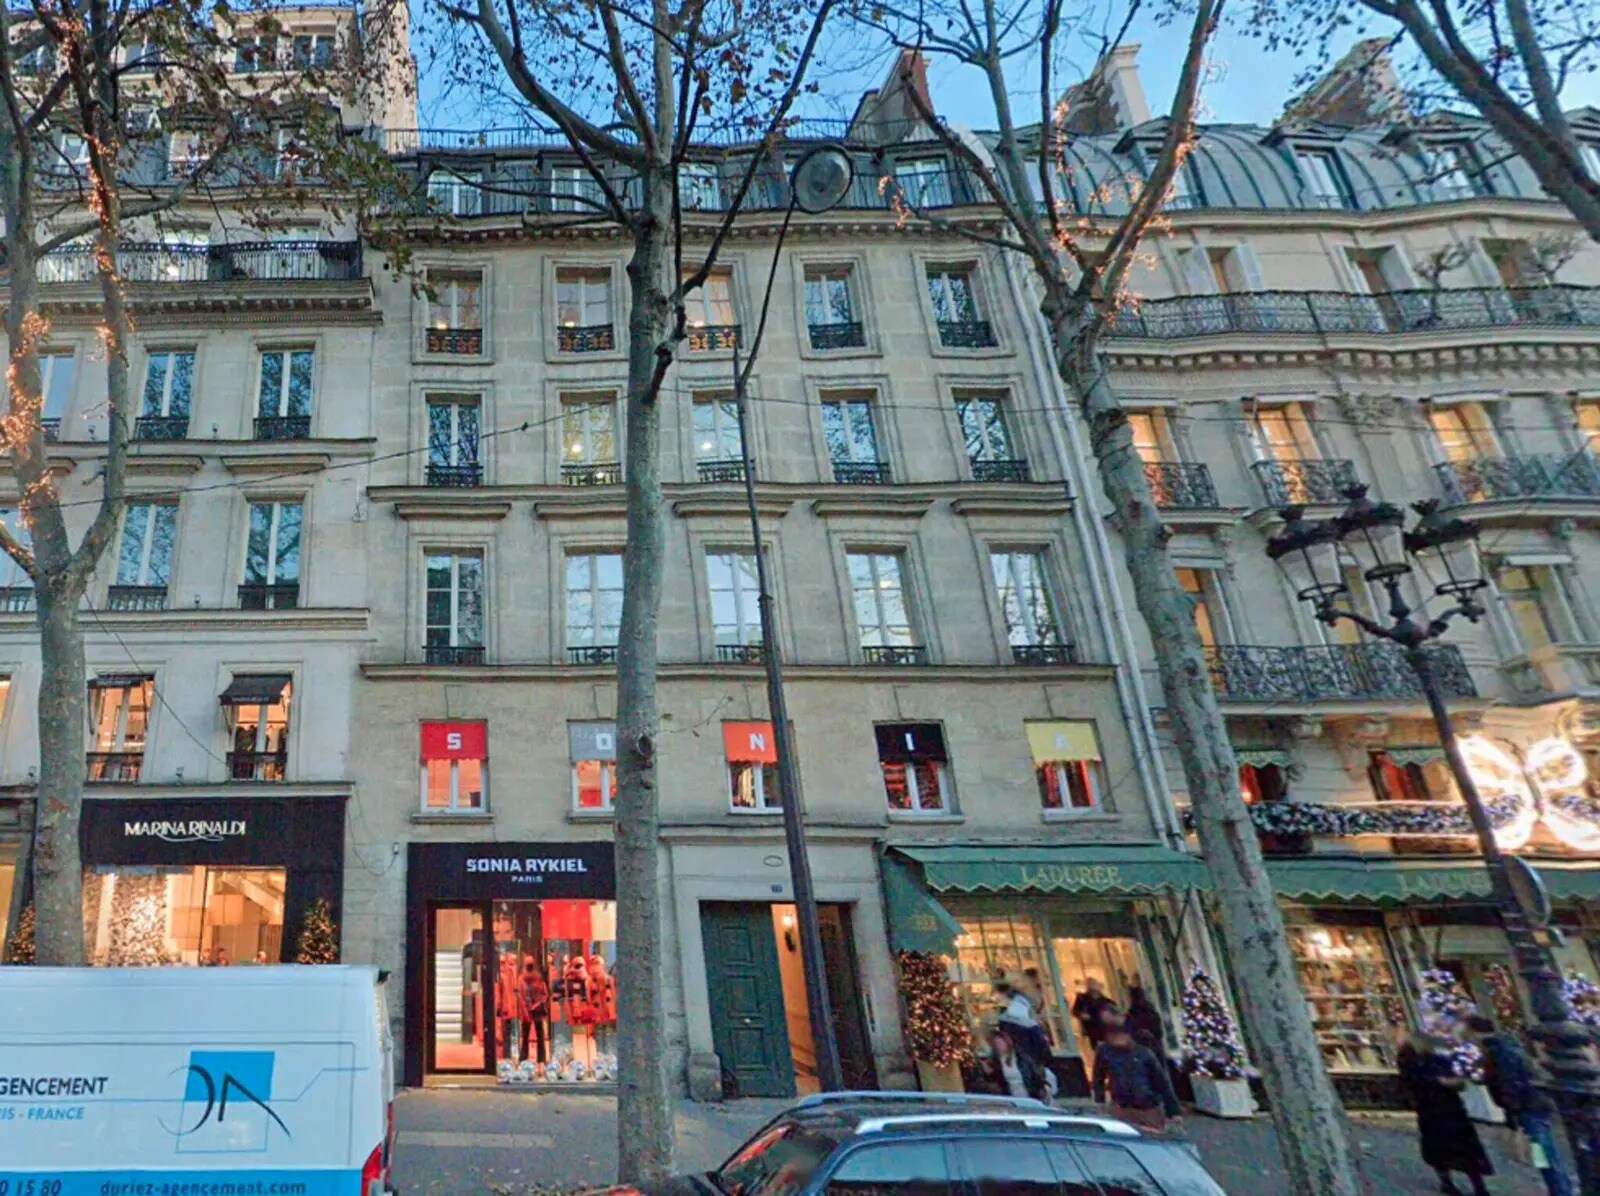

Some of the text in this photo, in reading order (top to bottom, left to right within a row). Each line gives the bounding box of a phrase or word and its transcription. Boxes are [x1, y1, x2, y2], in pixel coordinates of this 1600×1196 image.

[447, 733, 462, 750] S
[748, 732, 766, 752] N
[905, 733, 915, 750] I
[1052, 731, 1072, 752] A
[125, 821, 247, 839] MARINA RINALDI
[466, 858, 588, 872] SONIA RYKIEL
[511, 875, 544, 884] PARIS
[28, 1106, 85, 1121] FRANCE
[16, 1179, 35, 1196] 15
[41, 1179, 63, 1196] 80
[101, 1179, 307, 1196] duriez-agencement.com
